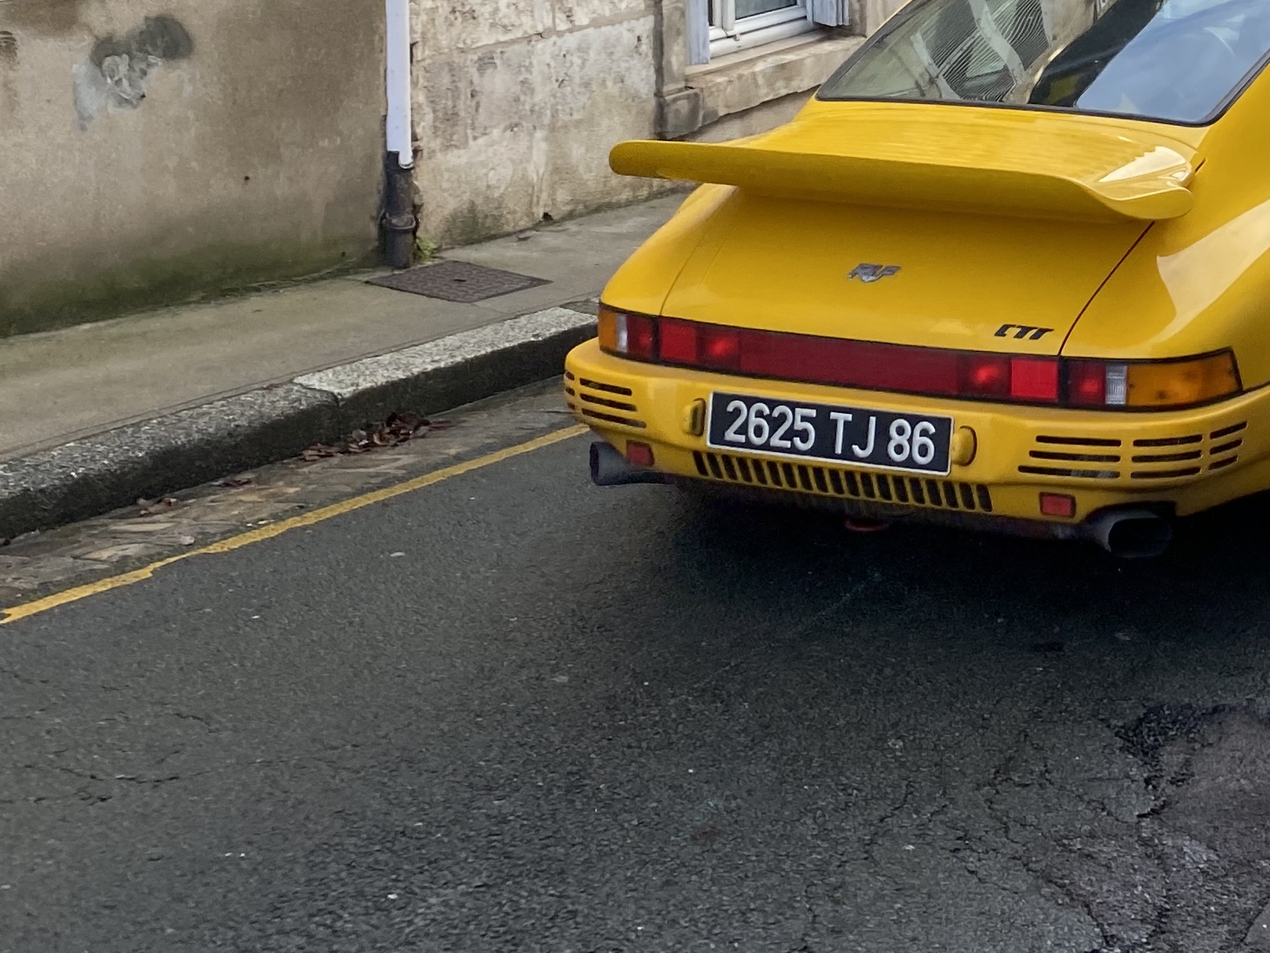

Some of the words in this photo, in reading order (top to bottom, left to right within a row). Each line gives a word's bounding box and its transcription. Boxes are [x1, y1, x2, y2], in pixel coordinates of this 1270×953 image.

[724, 400, 817, 452] 2625
[829, 411, 877, 459] TJ
[887, 418, 937, 466] 86
